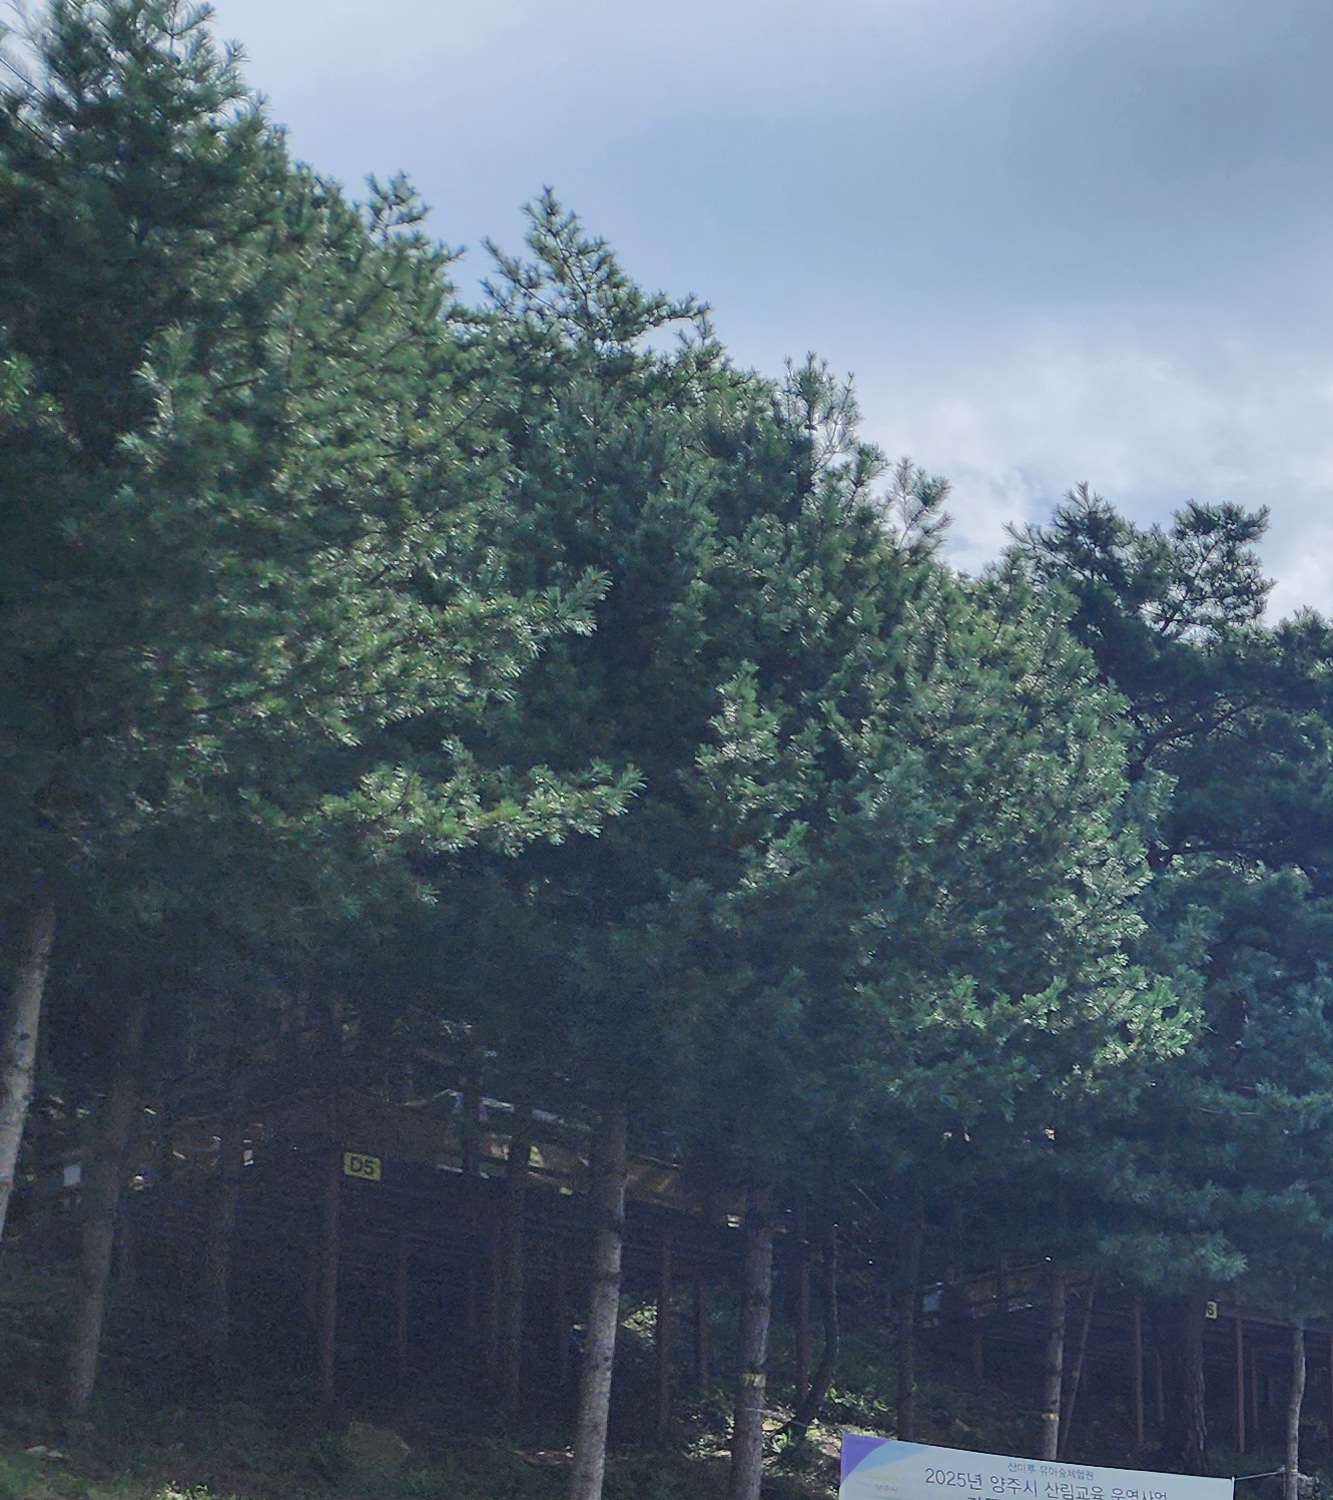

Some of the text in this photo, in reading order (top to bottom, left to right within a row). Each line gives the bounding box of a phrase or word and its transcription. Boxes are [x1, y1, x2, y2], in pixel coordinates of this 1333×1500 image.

[350, 1156, 374, 1176] D5
[925, 1468, 982, 1491] 2025년
[990, 1475, 1038, 1497] 양주시
[1040, 1465, 1094, 1480] 유아숲체험원
